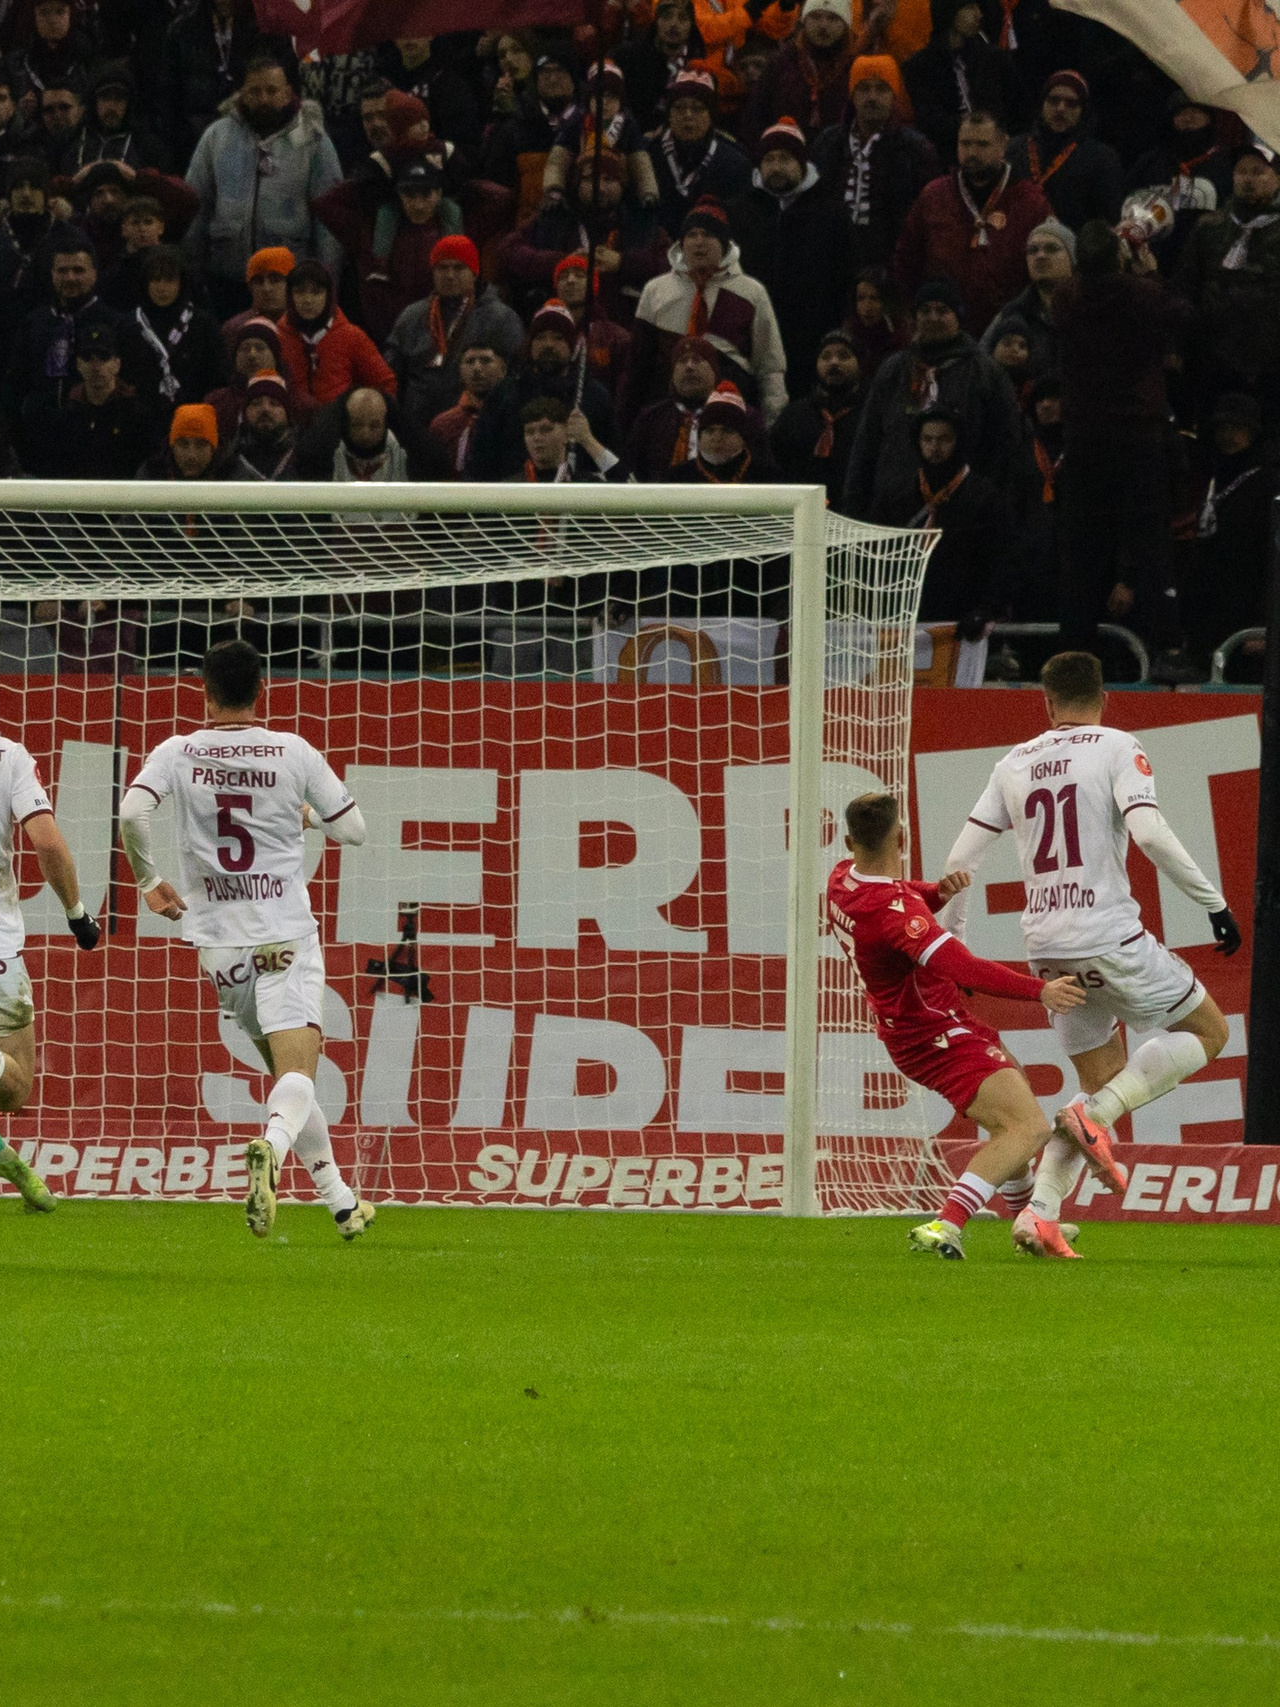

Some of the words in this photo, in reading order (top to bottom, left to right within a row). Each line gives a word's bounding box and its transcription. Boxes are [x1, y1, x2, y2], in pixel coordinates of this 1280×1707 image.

[1030, 759, 1072, 782] IGNAT
[214, 793, 256, 872] 5
[1024, 783, 1084, 875] 21
